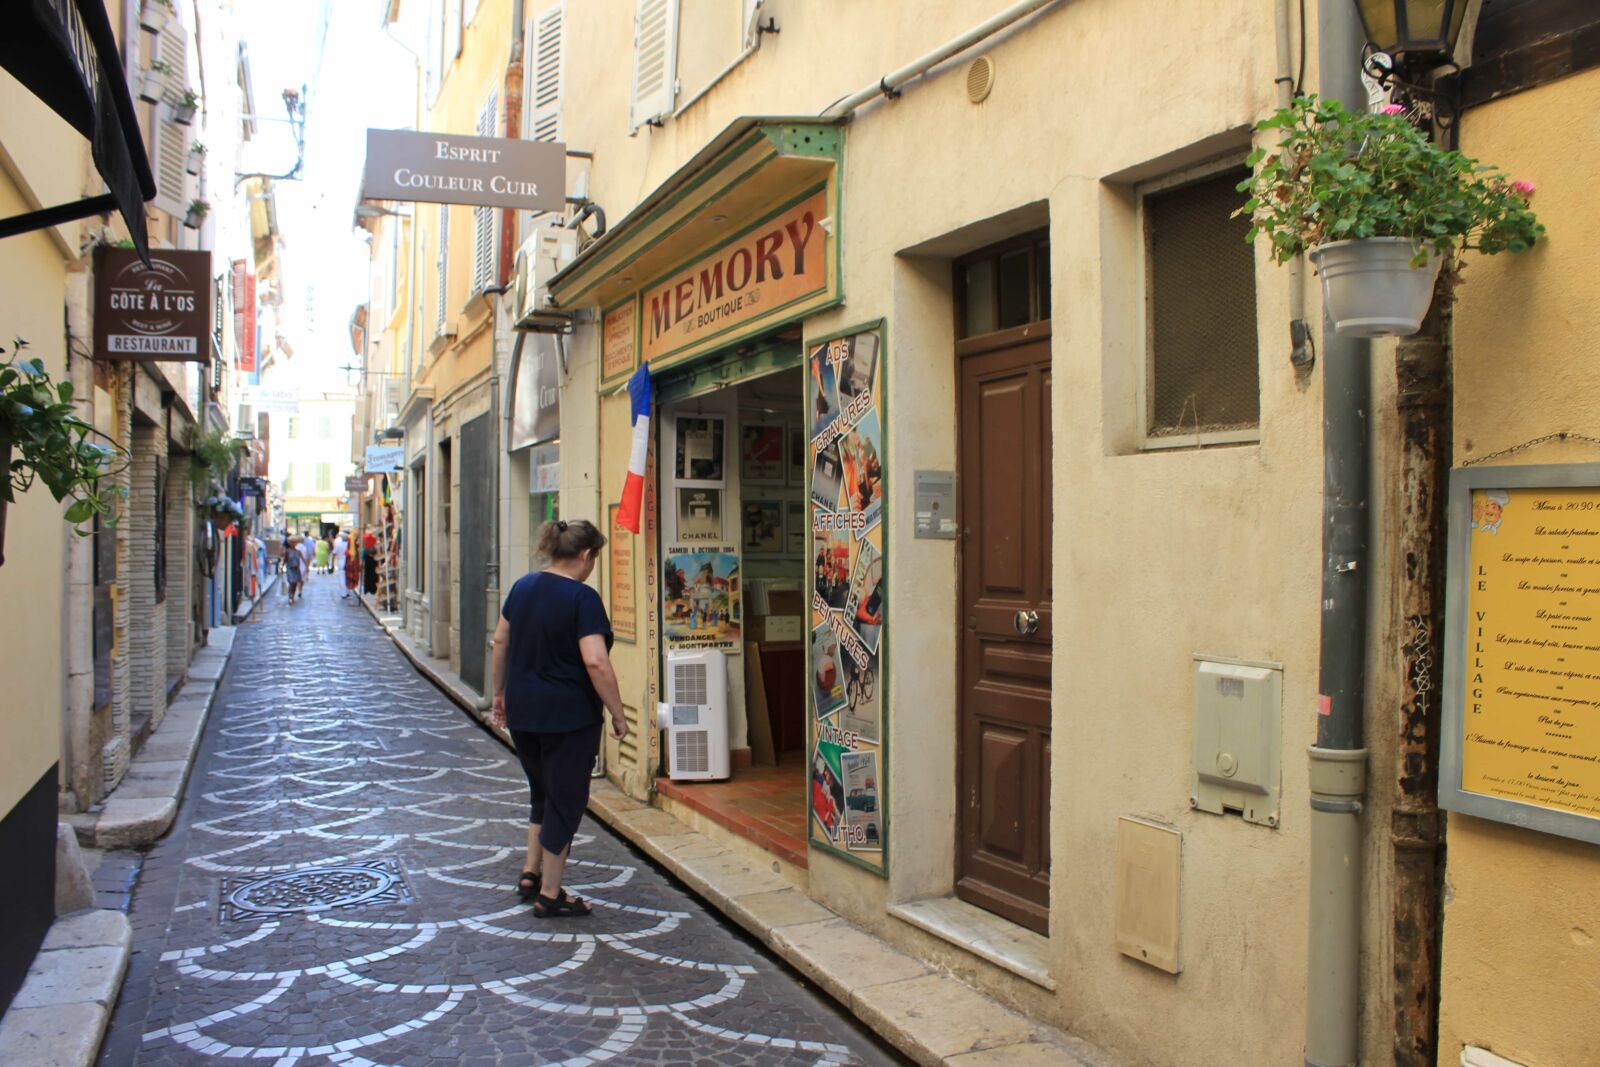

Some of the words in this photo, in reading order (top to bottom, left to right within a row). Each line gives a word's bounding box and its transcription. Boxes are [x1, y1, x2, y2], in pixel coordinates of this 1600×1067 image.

[649, 210, 815, 345] MEMORY
[110, 291, 145, 310] CÔTE
[150, 292, 159, 310] À
[164, 296, 195, 312] L'OS
[697, 296, 743, 328] BOUTIQUE
[114, 336, 192, 352] RESTAURANT
[827, 343, 849, 361] ADS
[814, 513, 866, 530] AFFICHES
[681, 531, 719, 540] CHANEL
[1478, 565, 1487, 591] LE
[814, 594, 868, 669] PEINTURES
[648, 558, 658, 748] ADVERTISING
[679, 641, 734, 649] MONTMARTRE
[1473, 611, 1486, 714] VILLAGE
[816, 723, 858, 749] VINTAGE
